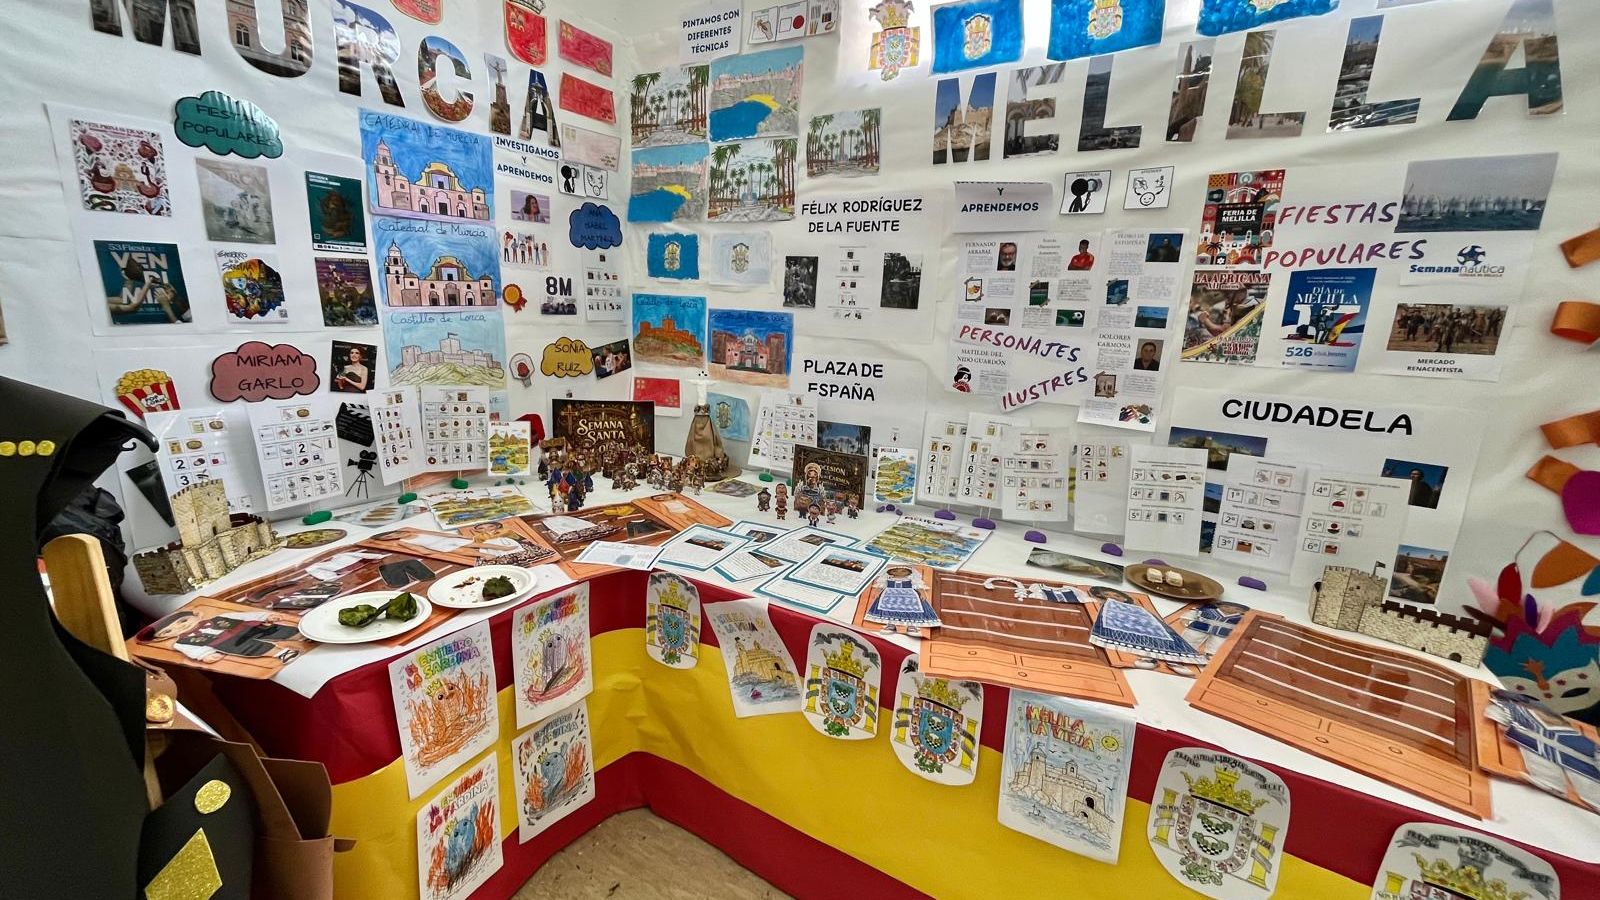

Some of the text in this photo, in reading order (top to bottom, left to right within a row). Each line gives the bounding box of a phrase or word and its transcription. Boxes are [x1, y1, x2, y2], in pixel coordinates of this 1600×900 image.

[682, 9, 740, 28] PINTAMOS CON
[687, 26, 732, 40] DIFERENTES
[691, 40, 729, 54] TÉCNICAS
[932, 0, 1566, 164] MELILLA
[495, 137, 560, 159] INVESTIGAMOS
[521, 156, 527, 165] Y
[496, 164, 553, 184] APRENDEMOS
[997, 187, 1004, 196] Y
[801, 195, 923, 216] FÉLIX RODRÍGUEZ
[961, 202, 1040, 213] APRENDEMOS
[1277, 202, 1399, 226] FIESTAS
[808, 219, 901, 233] DE LA FUENTE
[110, 251, 169, 270] VEN
[1262, 239, 1428, 271] POPULARES
[545, 276, 572, 297] 8M
[1294, 292, 1359, 305] MELILLA
[391, 312, 435, 324] Castillo
[440, 311, 451, 323] de
[959, 325, 1082, 363] PERSONAJES
[1285, 346, 1314, 358] 526
[236, 353, 303, 367] MIRIAM
[556, 361, 581, 372] RUIZ
[1417, 357, 1456, 366] MERCADO
[803, 358, 884, 378] PLAZA DE
[1406, 365, 1464, 374] RENACENTISTA
[237, 376, 305, 391] GARLO
[1002, 366, 1089, 410] ILUSTRES
[807, 380, 876, 402] ESPAÑA
[1221, 399, 1414, 436] CIUDADELA
[576, 418, 624, 436] SEMANA
[587, 430, 626, 445] SANTA
[299, 443, 305, 453] 2
[391, 444, 397, 453] 6
[1084, 447, 1091, 456] 2
[175, 459, 186, 470] 2
[385, 458, 391, 467] 6
[930, 454, 937, 463] 2
[970, 454, 975, 463] 1
[929, 465, 934, 473] 1
[967, 465, 974, 473] 6
[1083, 471, 1089, 480] 1
[180, 475, 190, 486] 3
[928, 475, 933, 484] 1
[966, 476, 972, 485] 1
[927, 486, 931, 494] 1
[964, 487, 970, 496] 3
